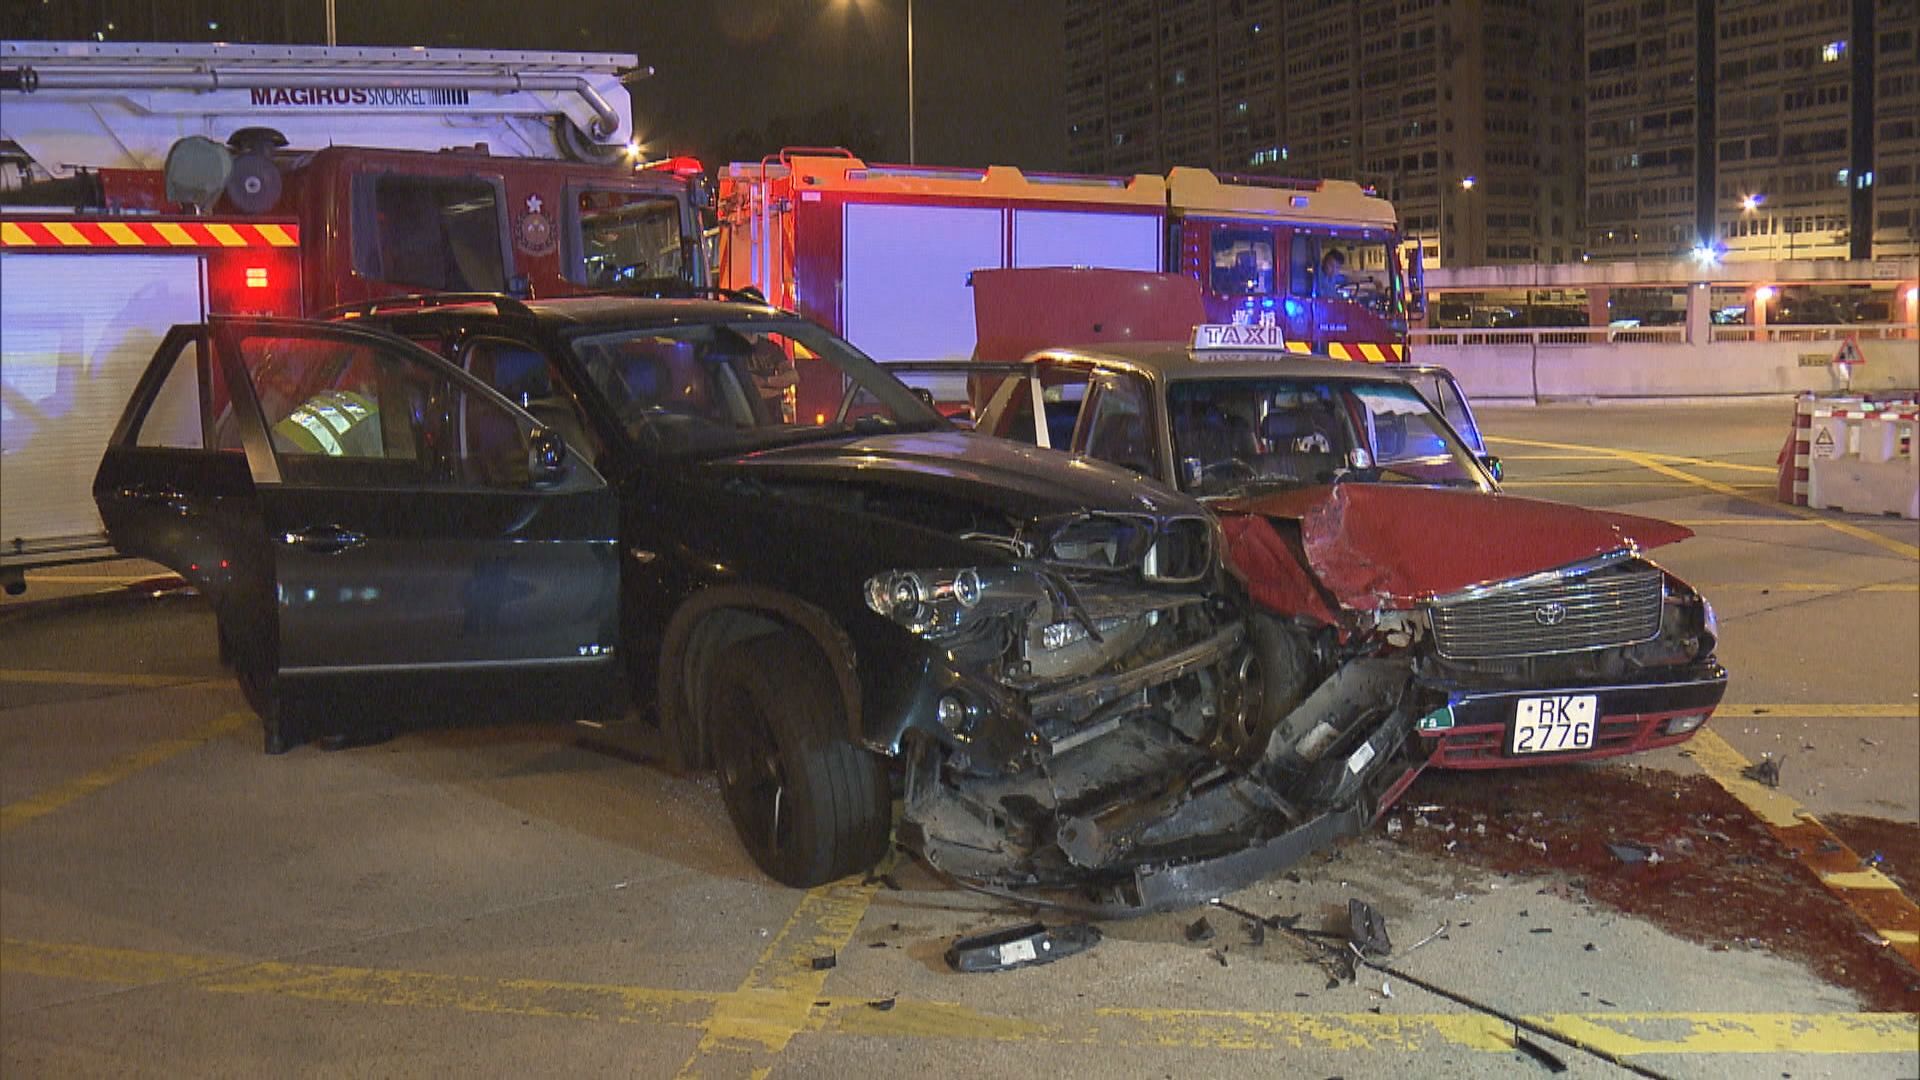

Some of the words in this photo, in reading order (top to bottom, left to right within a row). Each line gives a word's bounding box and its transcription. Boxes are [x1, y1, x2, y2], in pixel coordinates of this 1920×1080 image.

[250, 87, 368, 105] MAGIRUS
[1205, 326, 1277, 344] TAXI
[1539, 696, 1574, 723] RK
[1518, 722, 1590, 751] 2776
